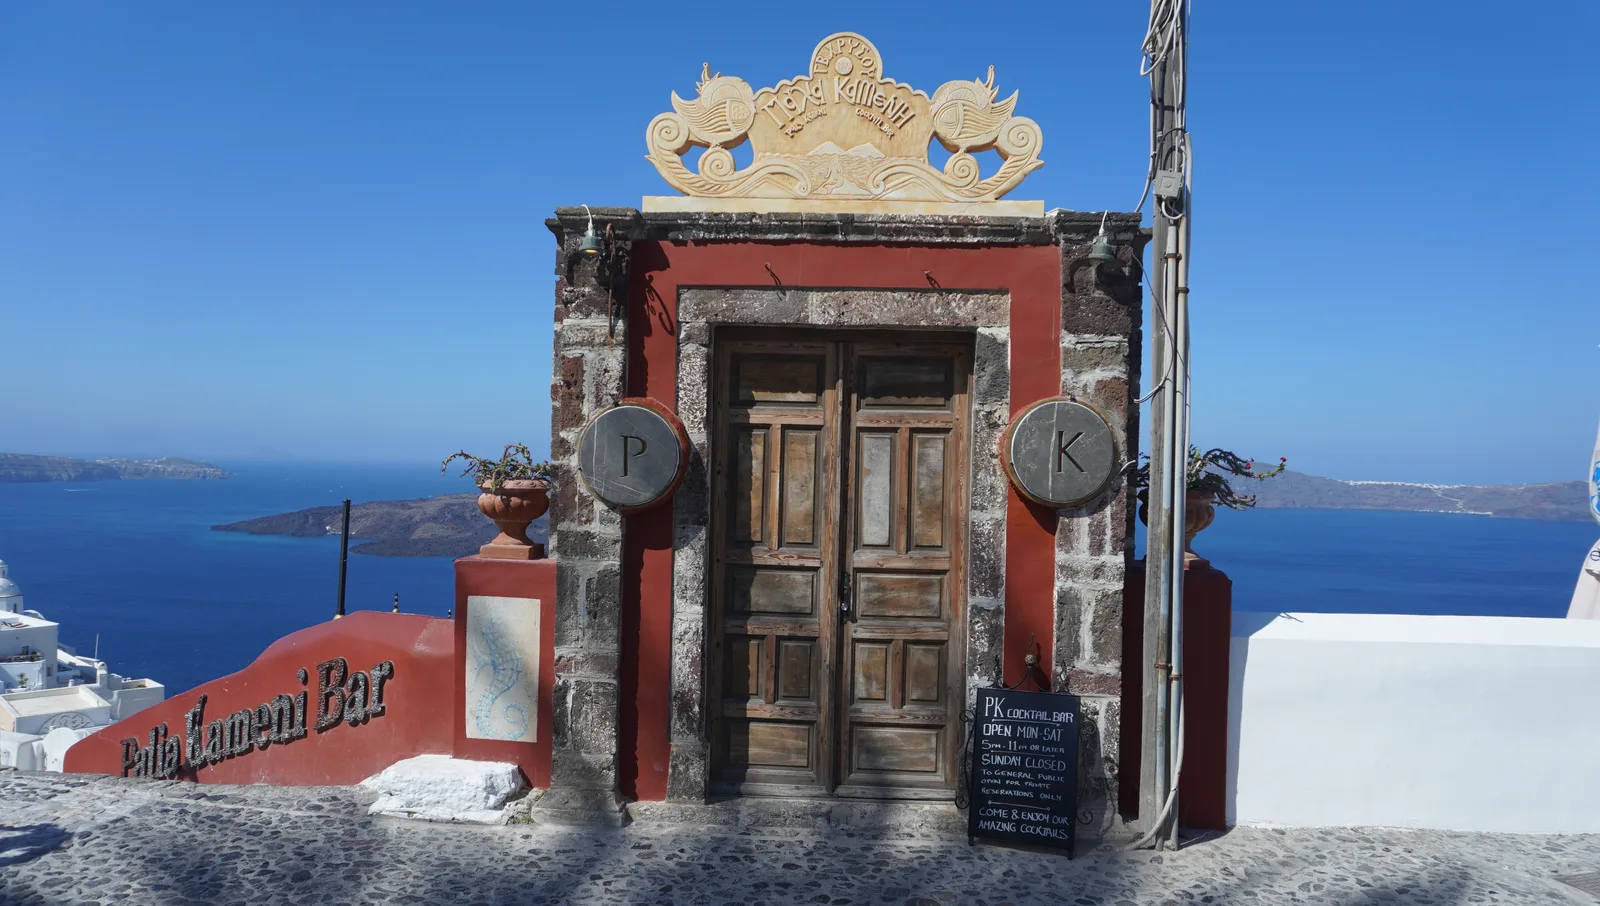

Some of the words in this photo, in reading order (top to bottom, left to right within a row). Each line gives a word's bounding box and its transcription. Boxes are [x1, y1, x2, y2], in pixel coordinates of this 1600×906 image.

[620, 434, 648, 478] P
[1056, 430, 1088, 475] K
[120, 722, 182, 778] Palia
[184, 667, 308, 770] Kameni
[313, 657, 394, 734] Bar
[984, 696, 1005, 718] PK
[1007, 709, 1051, 721] COCKTAIL
[1052, 711, 1073, 723] BAR
[983, 723, 1012, 737] OPEN
[1042, 746, 1065, 754] LATER
[981, 753, 1021, 767] SUNDAY
[1025, 757, 1066, 772] CLOSED
[994, 770, 1035, 780] GENERAL
[1038, 773, 1065, 782] PUBLIC
[1024, 781, 1051, 789] PRIVATE
[981, 787, 1034, 798] RESERVATIONS
[1039, 792, 1062, 801] ONLY
[978, 807, 1008, 818] COME
[1011, 809, 1020, 820] &
[1021, 811, 1049, 823] ENJOY
[1052, 815, 1069, 826] OUR
[978, 819, 1017, 833] AMAZING
[1020, 823, 1068, 840] COCKTAILS
